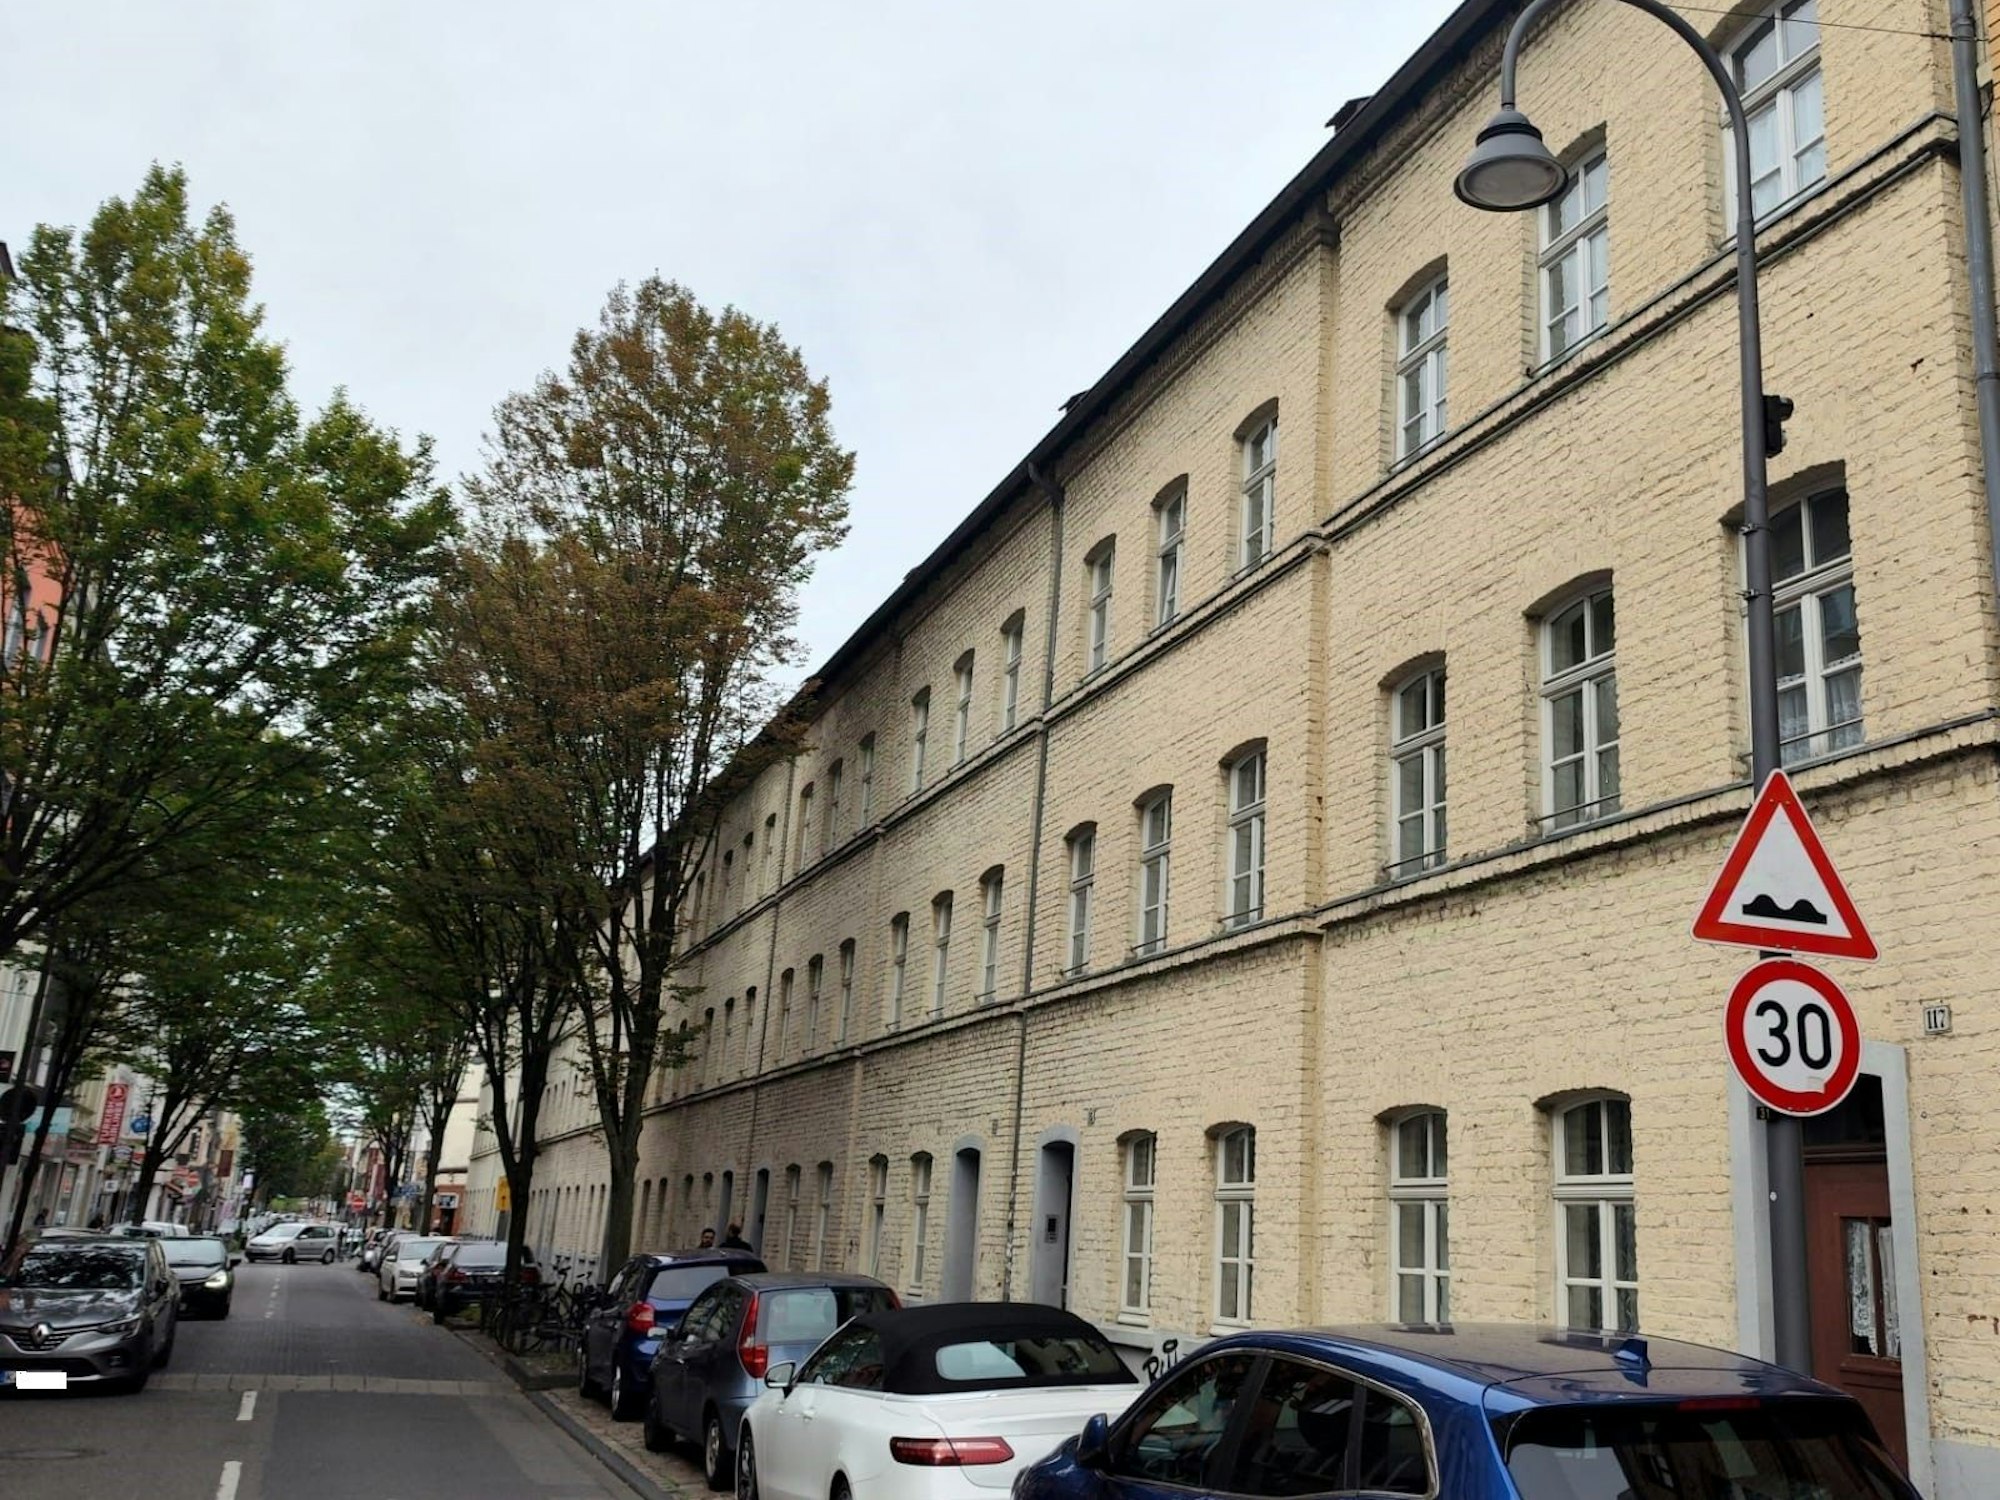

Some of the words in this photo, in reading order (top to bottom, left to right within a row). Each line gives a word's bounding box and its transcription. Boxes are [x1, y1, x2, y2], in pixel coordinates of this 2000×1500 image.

[1755, 1000, 1832, 1070] 30
[1927, 1008, 1945, 1030] 117
[100, 1101, 115, 1142] TURKISH
